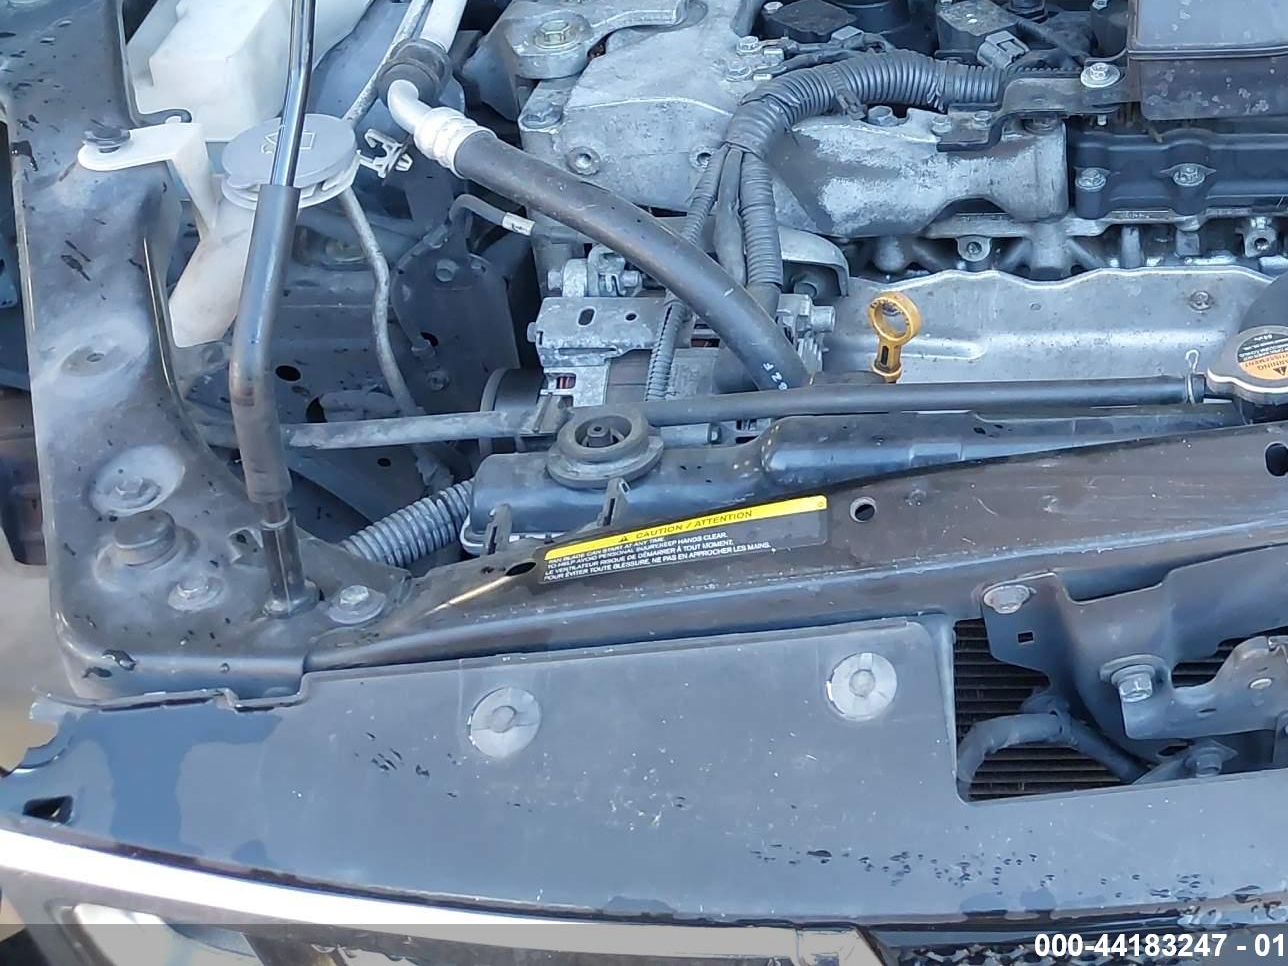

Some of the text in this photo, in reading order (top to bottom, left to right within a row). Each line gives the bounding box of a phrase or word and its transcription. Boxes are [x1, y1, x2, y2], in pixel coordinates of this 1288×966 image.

[635, 525, 683, 539] CAUTION
[694, 510, 753, 528] ATTENTION
[543, 572, 564, 582] POUR
[565, 568, 589, 580] ÉVITER
[590, 565, 612, 575] TOUTE
[651, 556, 662, 564] NE
[662, 554, 677, 563] PAS
[678, 552, 688, 560] EN
[688, 546, 733, 559] APPROCHER
[733, 545, 747, 554] LES
[747, 542, 771, 552] MAINS.
[547, 562, 557, 570] TO
[558, 559, 576, 569] HELP
[576, 555, 598, 565] AVOID
[598, 547, 635, 560] PERSONAL
[678, 535, 703, 545] HANDS
[703, 531, 728, 541] CLEAR.
[555, 561, 600, 574] VENTILATEUR
[600, 557, 626, 568] RISQUE
[627, 553, 636, 561] DE
[637, 546, 676, 559] DÉMARRER
[683, 543, 701, 552] TOUT
[702, 539, 734, 549] MOMENT.
[563, 552, 586, 562] BLADE
[586, 549, 602, 558] CAN
[602, 544, 624, 554] START
[633, 539, 648, 548] ANY
